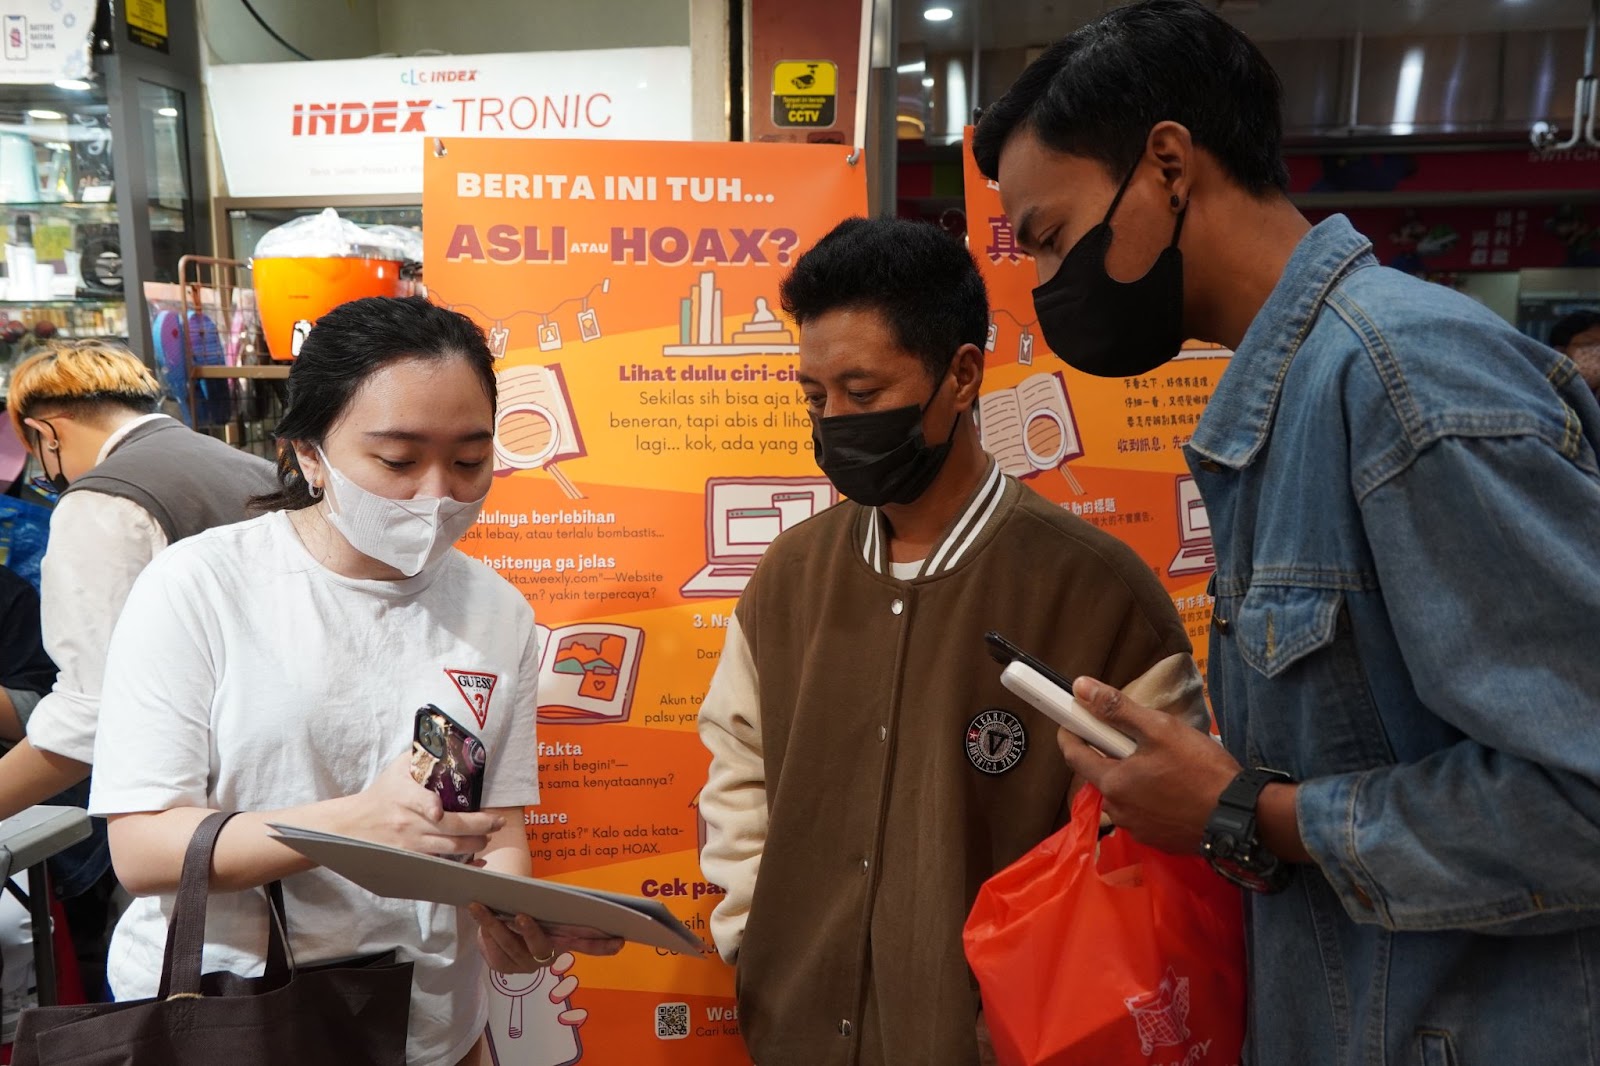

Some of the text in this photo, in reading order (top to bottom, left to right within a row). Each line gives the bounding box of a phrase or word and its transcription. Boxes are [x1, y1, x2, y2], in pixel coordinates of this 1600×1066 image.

[430, 69, 479, 83] INDEX
[292, 93, 613, 136] INDEX TRONIC
[788, 110, 820, 122] CCTV
[457, 172, 775, 204] BERITA INI TUH...
[445, 223, 800, 267] ASLI ATAU HOAX?
[619, 364, 677, 382] Lihat
[680, 364, 727, 382] dulu
[639, 389, 695, 405] Sekilas
[700, 389, 720, 405] sih
[726, 389, 759, 405] bisa
[763, 391, 790, 409] aja
[610, 412, 682, 429] beneran,
[687, 414, 719, 431] tapi
[724, 412, 758, 428] abis
[763, 412, 779, 427] di
[636, 434, 680, 455] lagi...
[685, 435, 717, 452] kok,
[721, 435, 754, 451] ada
[760, 438, 798, 455] yang
[532, 509, 616, 525] berlebihan
[486, 526, 523, 542] lebay,
[525, 529, 553, 539] atau
[556, 526, 594, 539] terlalu
[597, 526, 665, 539] bombastis...
[472, 554, 616, 573] bsitenya ga jelas
[548, 588, 580, 604] yakin
[583, 587, 657, 603] terpercaya?
[693, 614, 708, 628] 3.
[458, 675, 492, 690] GUESS
[659, 694, 687, 706] Akun
[645, 710, 676, 726] palsu
[974, 712, 1022, 768] LEARN AND SERVE
[538, 742, 583, 757] fakta
[968, 741, 997, 771] AMERICA
[554, 760, 569, 772] sih
[547, 778, 579, 789] sama
[583, 773, 675, 790] kenyataannya?
[524, 810, 568, 825] share
[542, 827, 589, 843] gratis?"
[592, 826, 620, 838] Kalo
[623, 825, 649, 837] ada
[651, 823, 684, 836] kata-
[555, 845, 577, 860] aja
[579, 844, 591, 857] di
[596, 846, 619, 859] cap
[622, 842, 661, 855] HOAX.
[641, 878, 727, 899] Cek pa
[682, 913, 705, 930] sih
[695, 1025, 719, 1037] Cari
